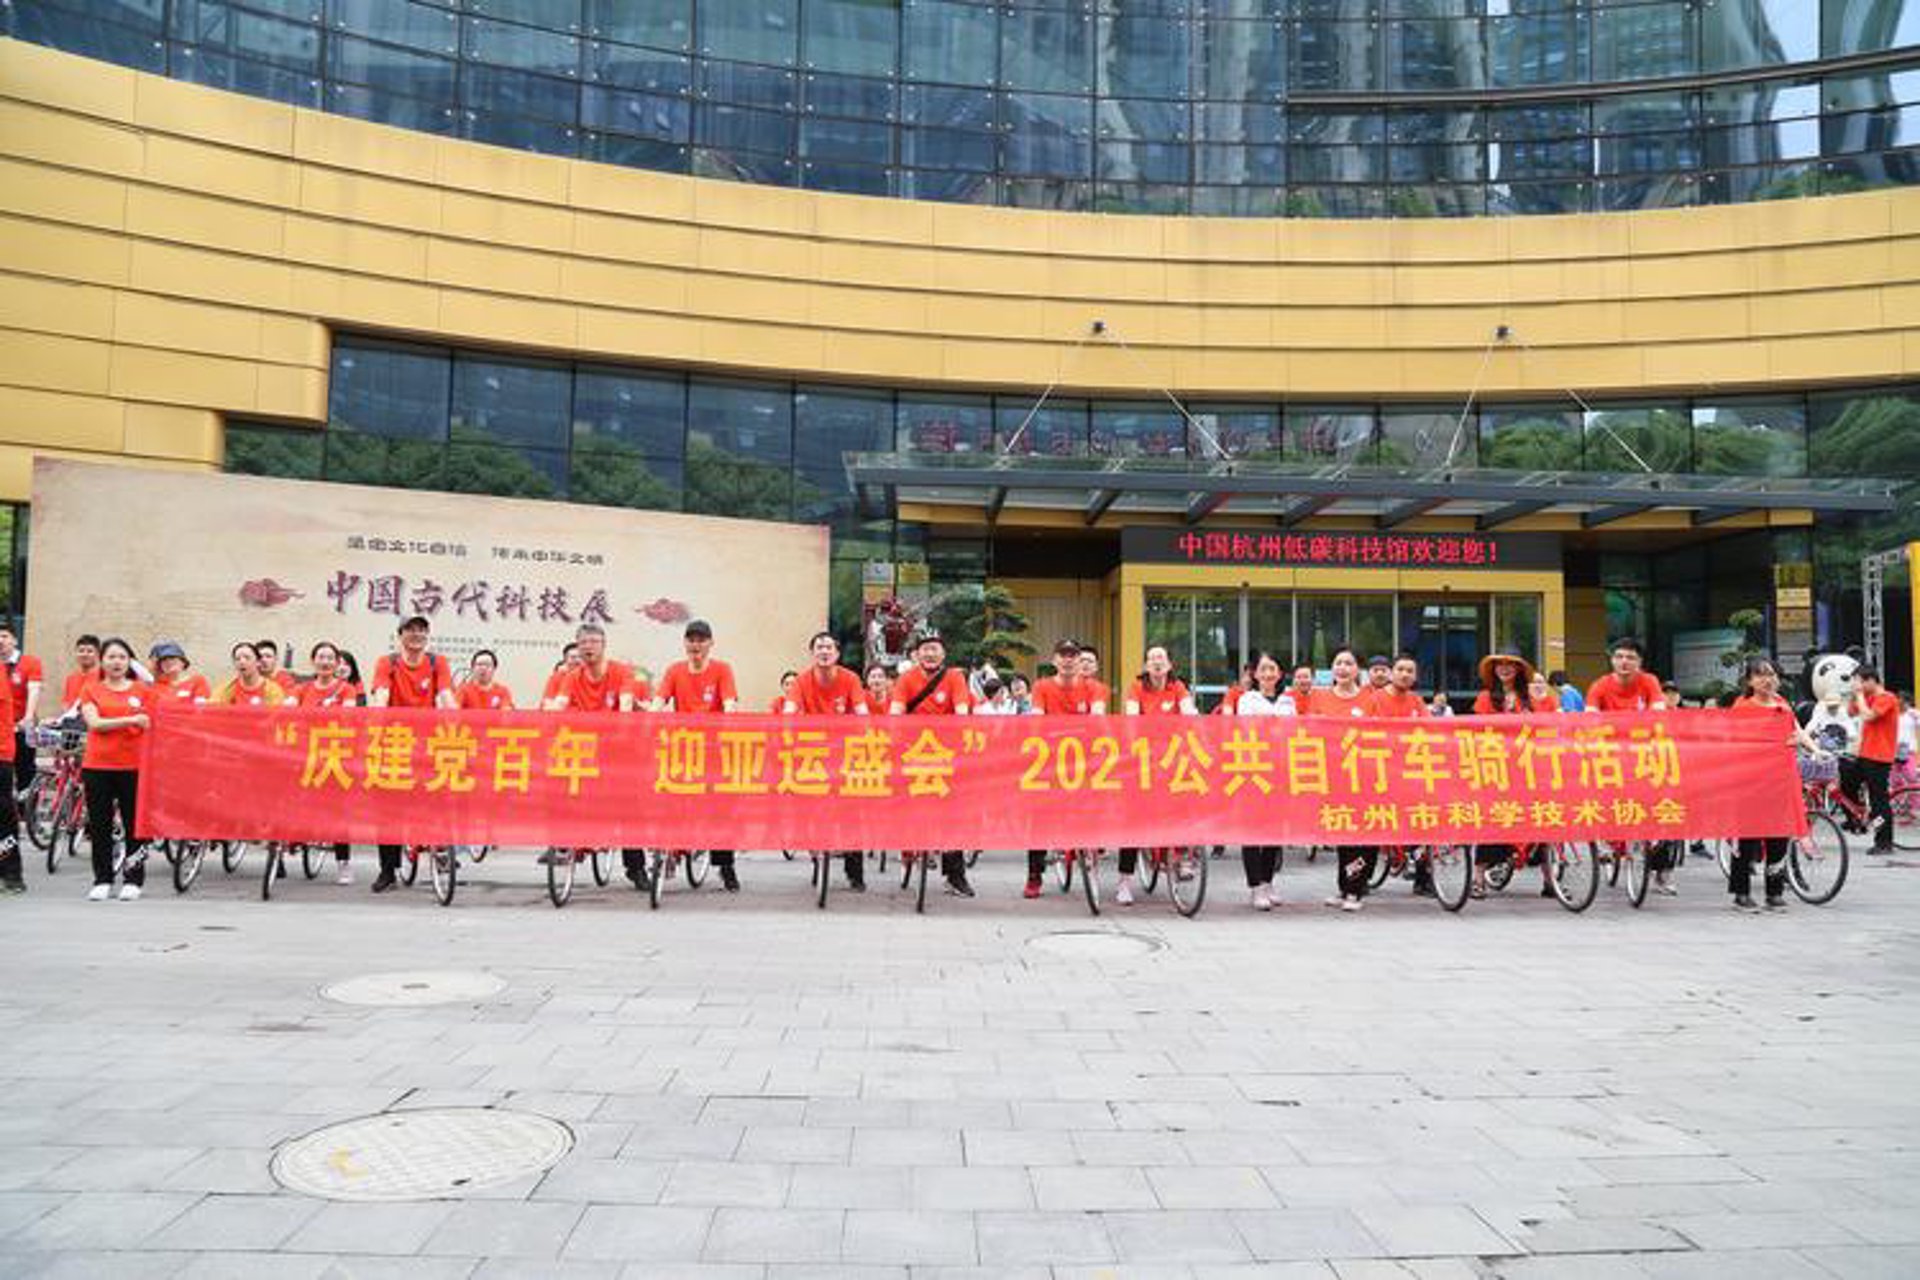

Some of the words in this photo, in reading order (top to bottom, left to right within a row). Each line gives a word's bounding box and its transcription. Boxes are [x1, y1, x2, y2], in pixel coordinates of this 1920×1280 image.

[326, 570, 615, 623] 中国古代科技展
[1019, 721, 1683, 796] 2021公共自行车骑行活动
[1318, 798, 1687, 833] 杭州市科学技术协会
